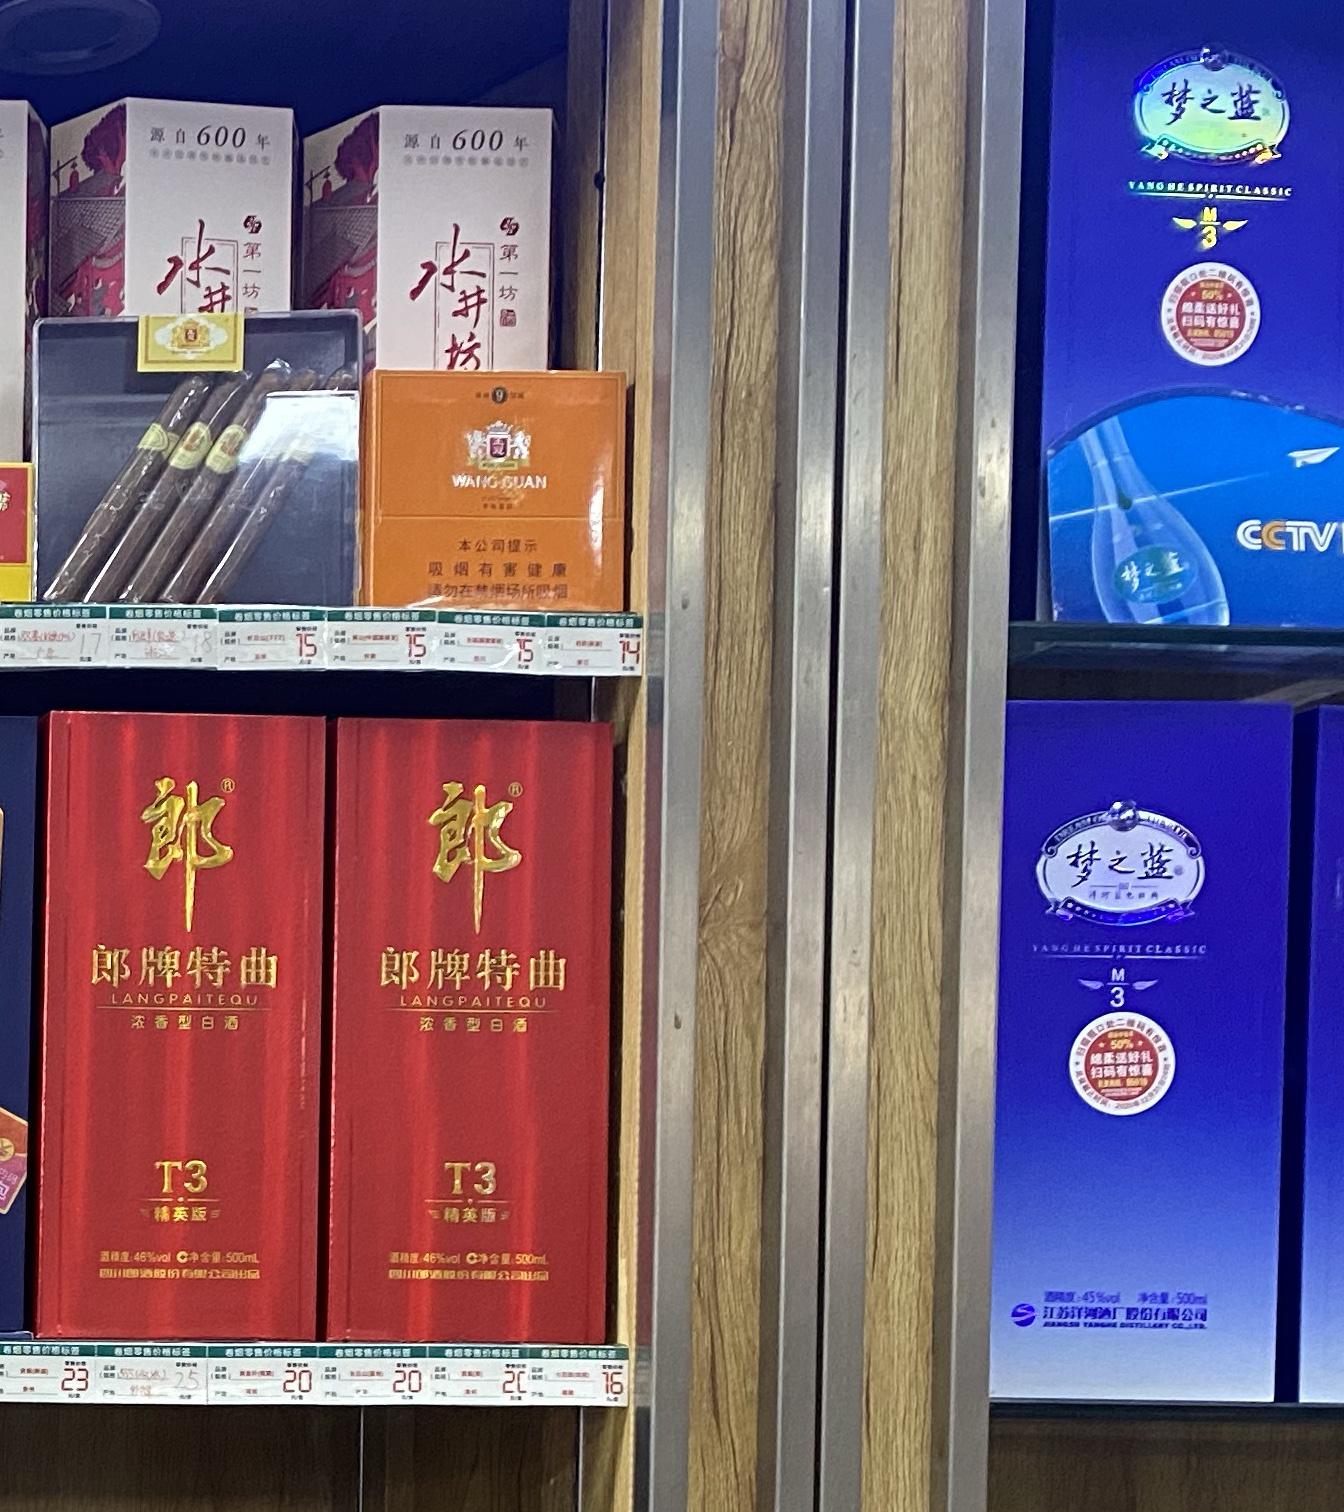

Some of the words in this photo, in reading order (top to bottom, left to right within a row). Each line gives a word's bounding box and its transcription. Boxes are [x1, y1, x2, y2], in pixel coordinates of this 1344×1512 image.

[1161, 82, 1262, 125] 梦之蓝
[142, 777, 234, 933] 郎
[1066, 840, 1175, 888] 梦之蓝
[90, 943, 279, 990] 郎牌特曲
[380, 945, 567, 992] 郎牌特曲
[111, 993, 260, 1007] LANGPAITEQU
[155, 1160, 208, 1194] T3
[444, 1161, 497, 1195] T3
[61, 1368, 89, 1391] 23
[283, 1370, 312, 1393] 20
[602, 1371, 623, 1394] 16
